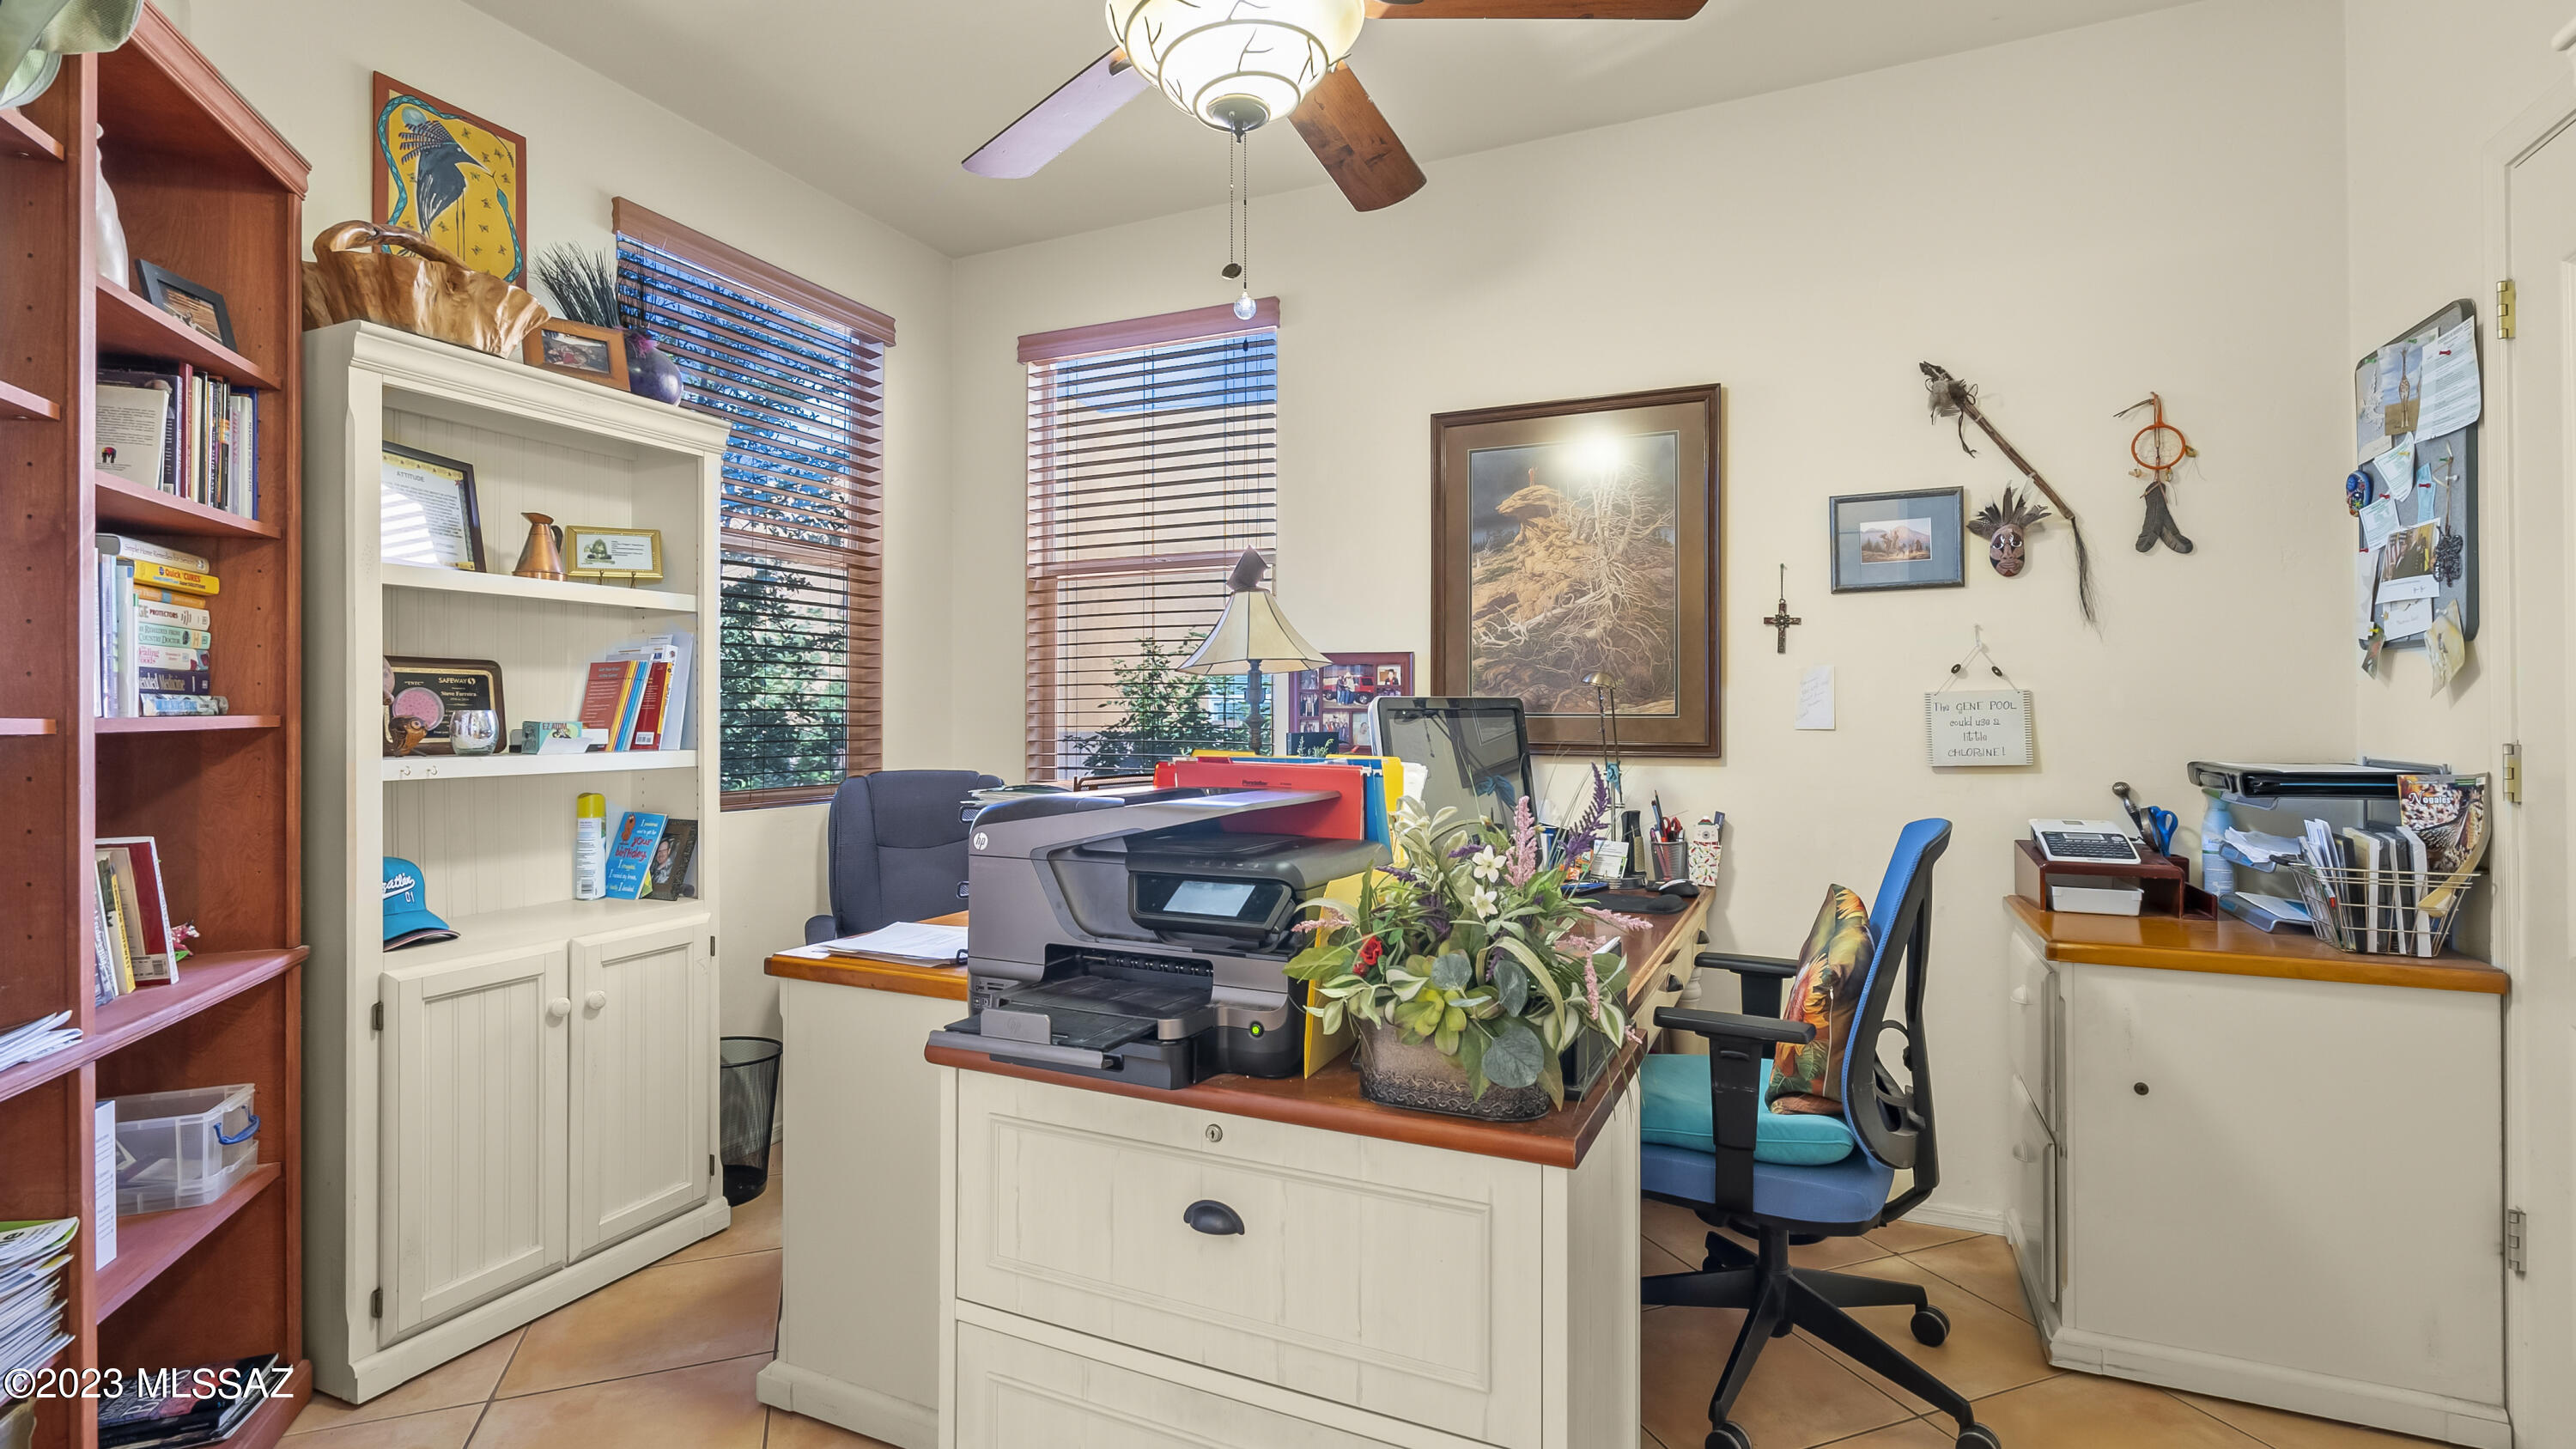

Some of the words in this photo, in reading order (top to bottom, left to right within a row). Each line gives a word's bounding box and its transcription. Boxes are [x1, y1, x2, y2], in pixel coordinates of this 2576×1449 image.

[397, 471, 425, 482] ATTITUDE
[140, 547, 152, 556] Home
[165, 569, 180, 579] Quick
[138, 605, 149, 618] GE
[149, 609, 178, 619] PROTECTORS
[162, 636, 180, 645] DOCTOR
[139, 672, 159, 690] ended
[1935, 702, 1950, 712] The
[1956, 701, 1984, 714] GENE
[1990, 701, 2017, 710] POOL
[1950, 716, 1972, 727] could
[1993, 717, 2001, 726] a
[1963, 732, 1988, 742] little
[1947, 746, 2007, 758] CHLORINE!
[631, 836, 653, 847] your
[974, 831, 988, 850] hp
